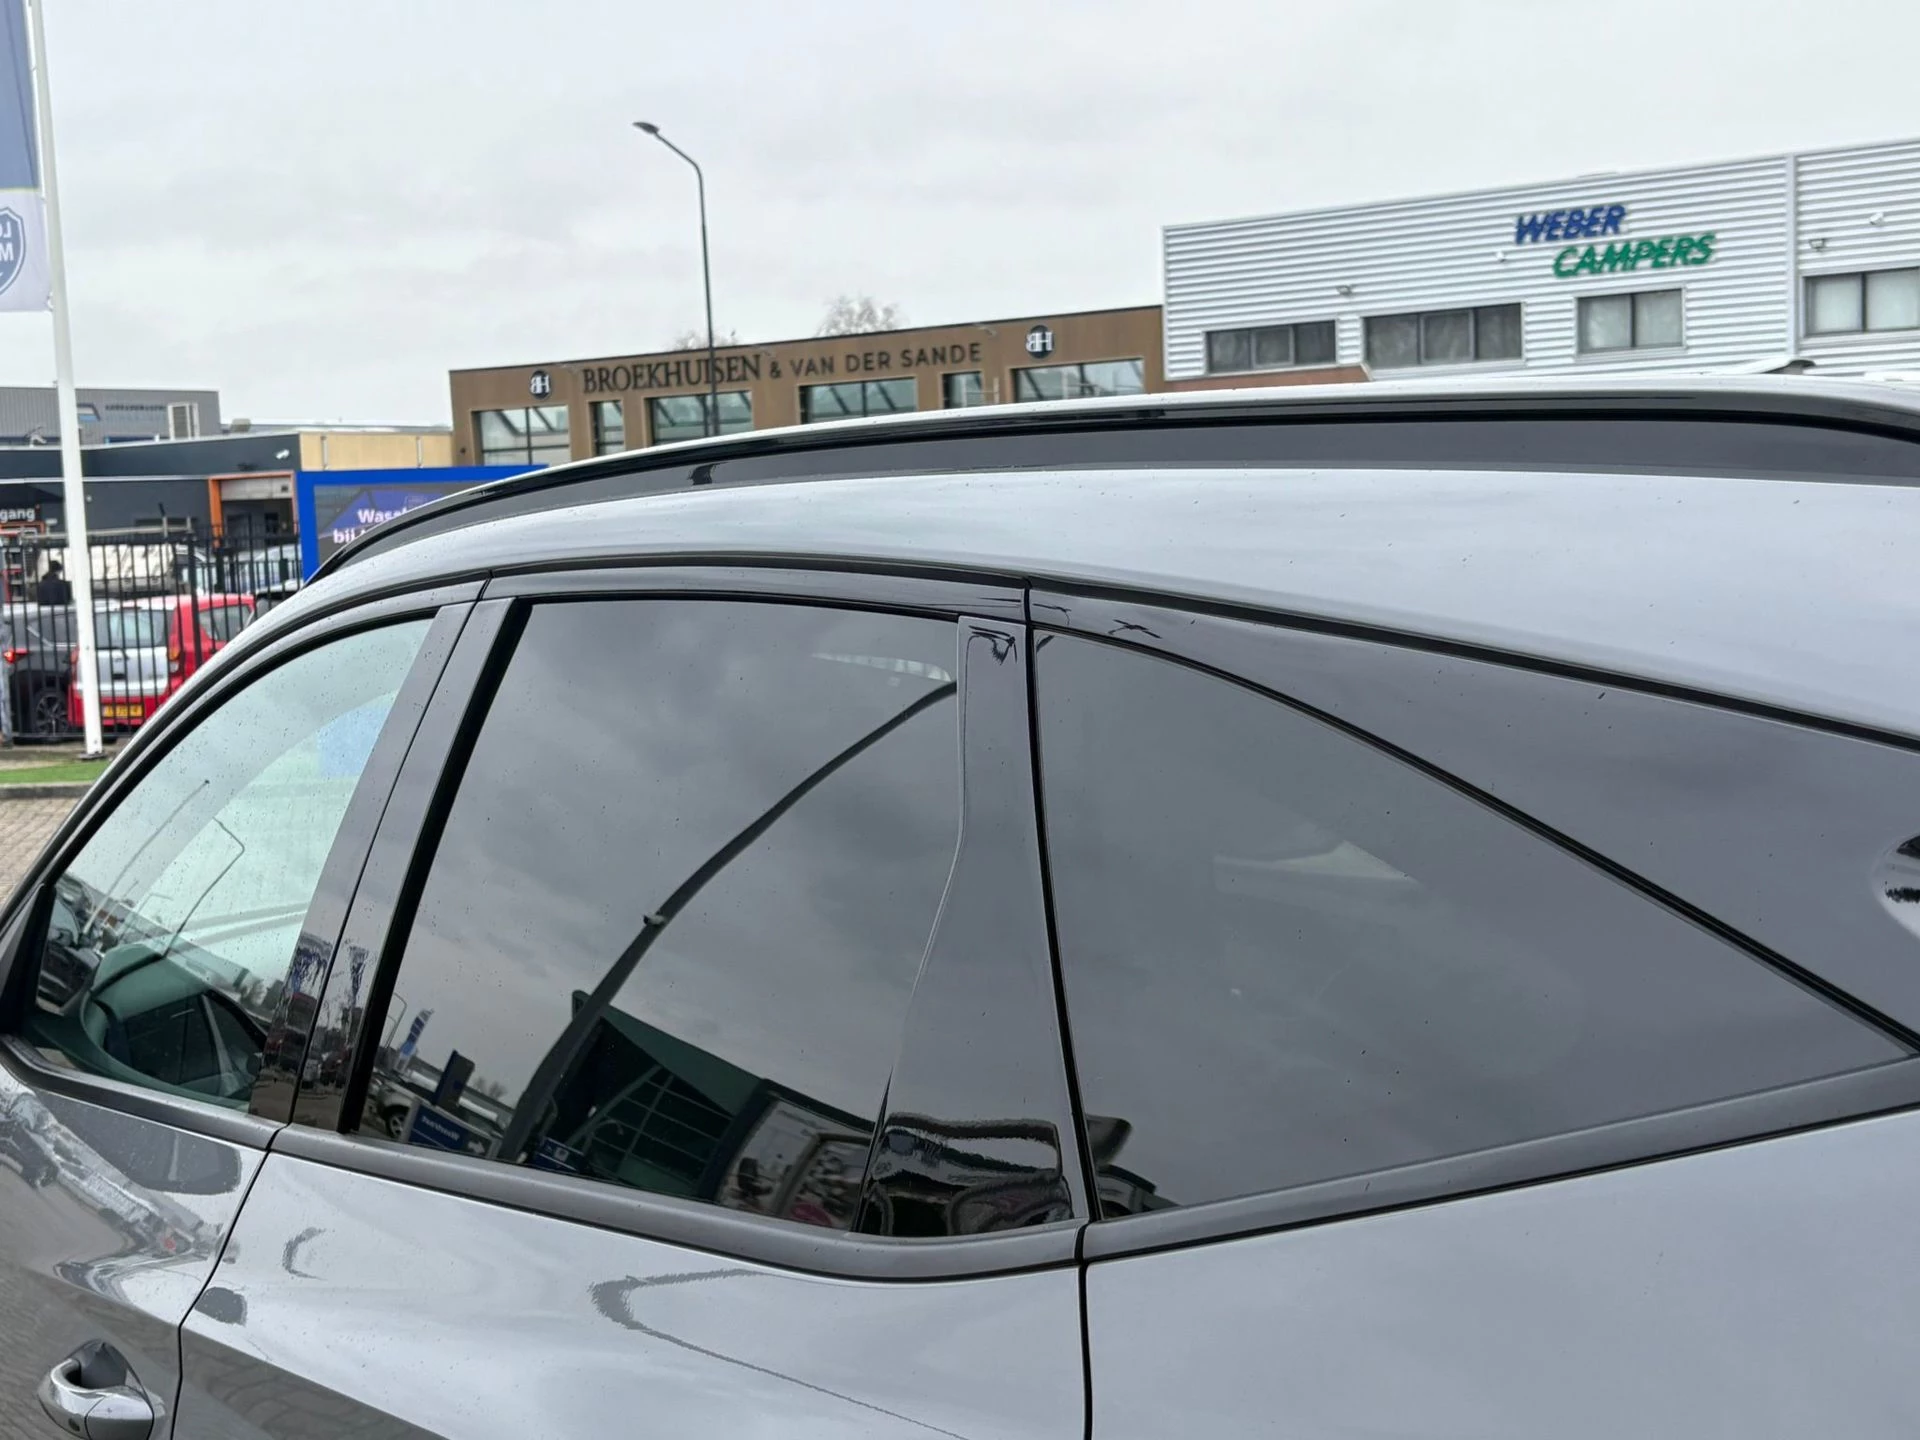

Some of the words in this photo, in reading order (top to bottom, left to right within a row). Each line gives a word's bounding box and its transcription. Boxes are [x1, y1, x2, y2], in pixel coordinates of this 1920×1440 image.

[1515, 205, 1626, 245] WEBER
[1552, 232, 1716, 278] CAMPERS
[582, 354, 762, 395] BROEKHUISEN
[770, 361, 782, 379] &
[790, 355, 834, 377] VAN
[845, 350, 892, 374] DER
[902, 342, 982, 369] SANDE
